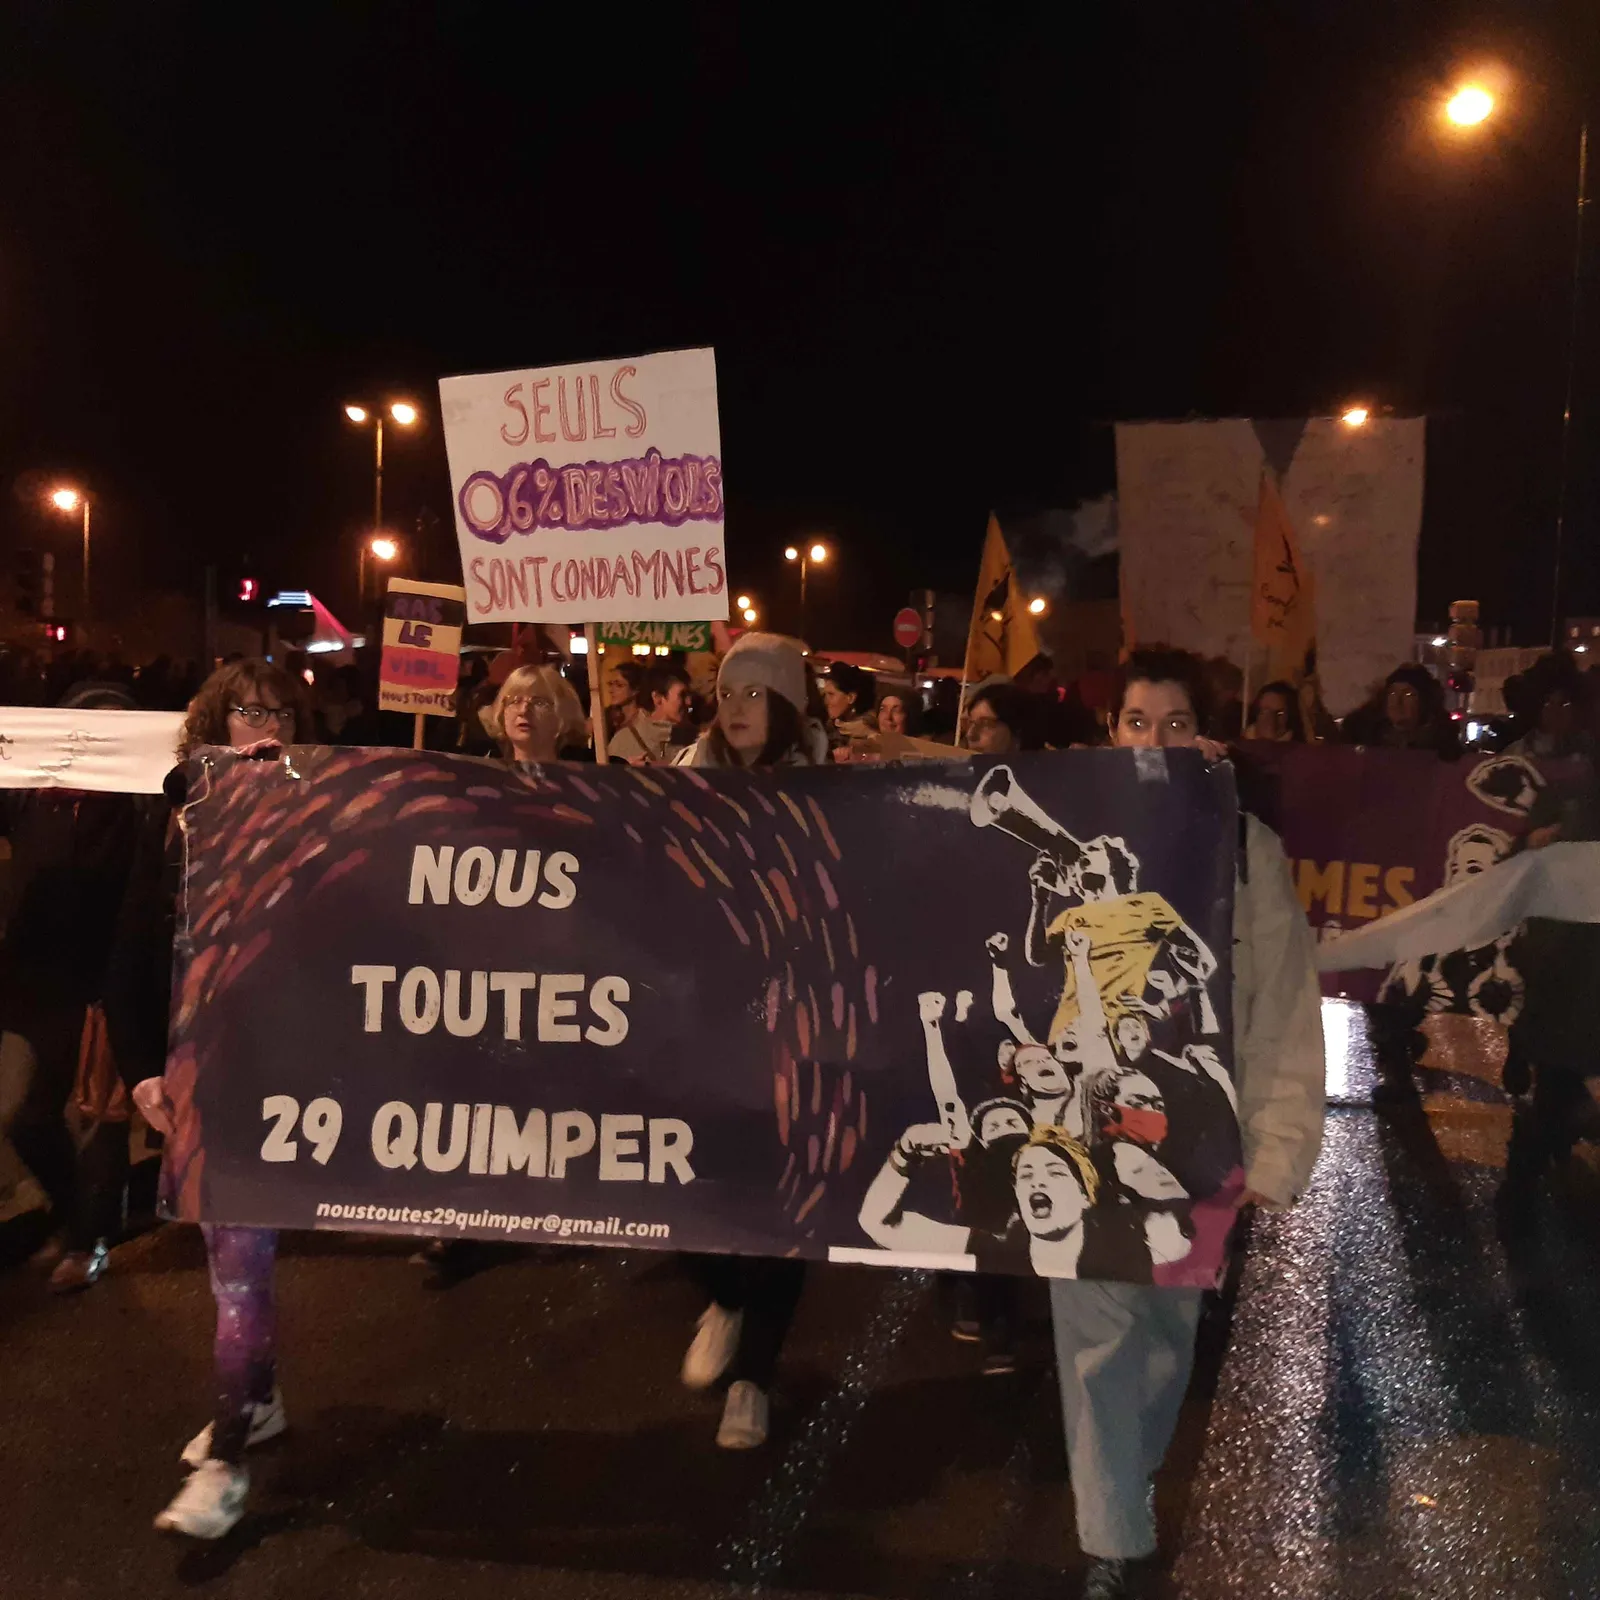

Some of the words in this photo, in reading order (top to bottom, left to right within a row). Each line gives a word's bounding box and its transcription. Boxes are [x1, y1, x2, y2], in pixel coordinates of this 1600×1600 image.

[500, 365, 647, 446] SEULS
[622, 452, 721, 518] VIOLS
[393, 598, 444, 624] RAS
[469, 556, 549, 615] SONT
[550, 547, 725, 603] CONDAMNES
[398, 621, 433, 648] LE
[389, 656, 447, 681] VIOL
[408, 844, 580, 909] NOUS
[1287, 857, 1416, 919] MES
[351, 965, 631, 1046] TOUTES
[260, 1094, 343, 1166] 29
[371, 1101, 696, 1185] QUIMPER
[316, 1201, 671, 1239] noustoutes29quimper@gmail.com
